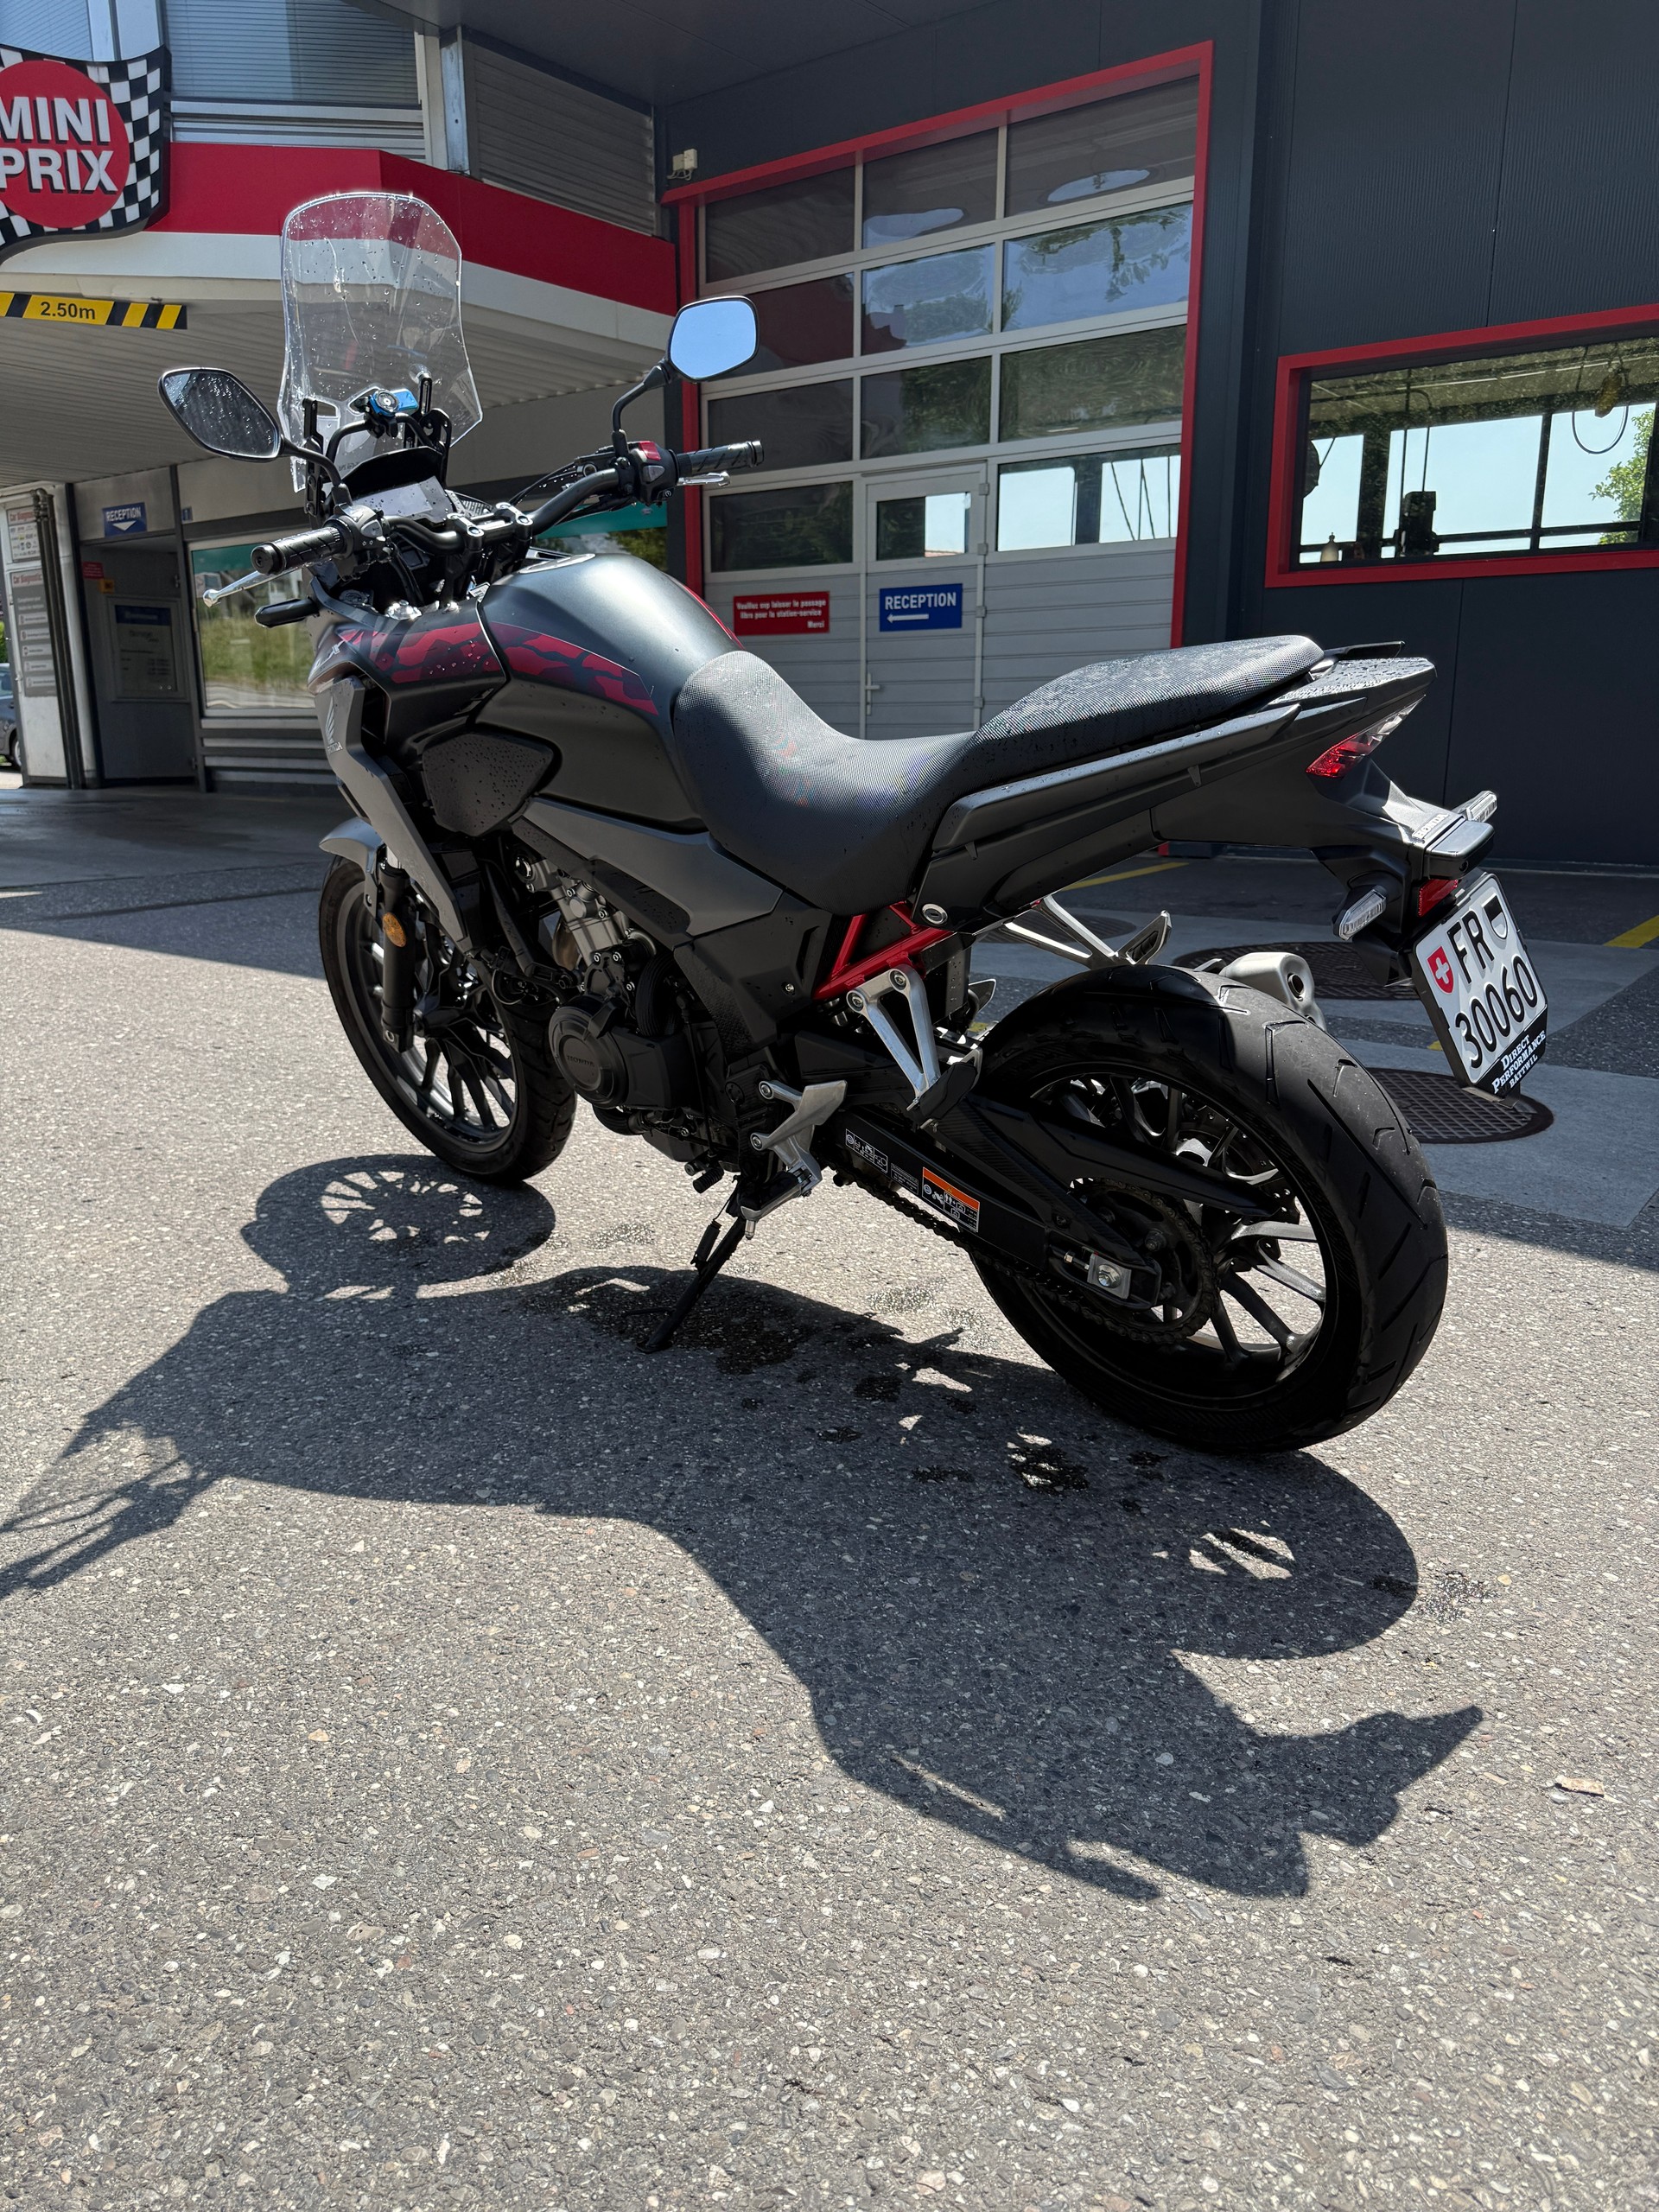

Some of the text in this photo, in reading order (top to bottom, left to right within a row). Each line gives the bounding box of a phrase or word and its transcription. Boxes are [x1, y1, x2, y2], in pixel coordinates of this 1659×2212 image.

[0, 96, 111, 143] MINI
[0, 147, 118, 192] PRIX
[40, 301, 96, 321] 2.50m
[105, 506, 142, 522] RECEPTION
[800, 599, 827, 608] passage
[884, 591, 957, 610] RECEPTION
[754, 611, 768, 620] pour
[776, 608, 822, 619] station-service
[807, 620, 825, 629] Merci
[1412, 814, 1450, 839] HONDA
[1446, 910, 1495, 984] FR
[1455, 954, 1538, 1070] 30060
[1491, 1029, 1547, 1095] PERFORMANCE
[1501, 1033, 1530, 1071] DIRECT
